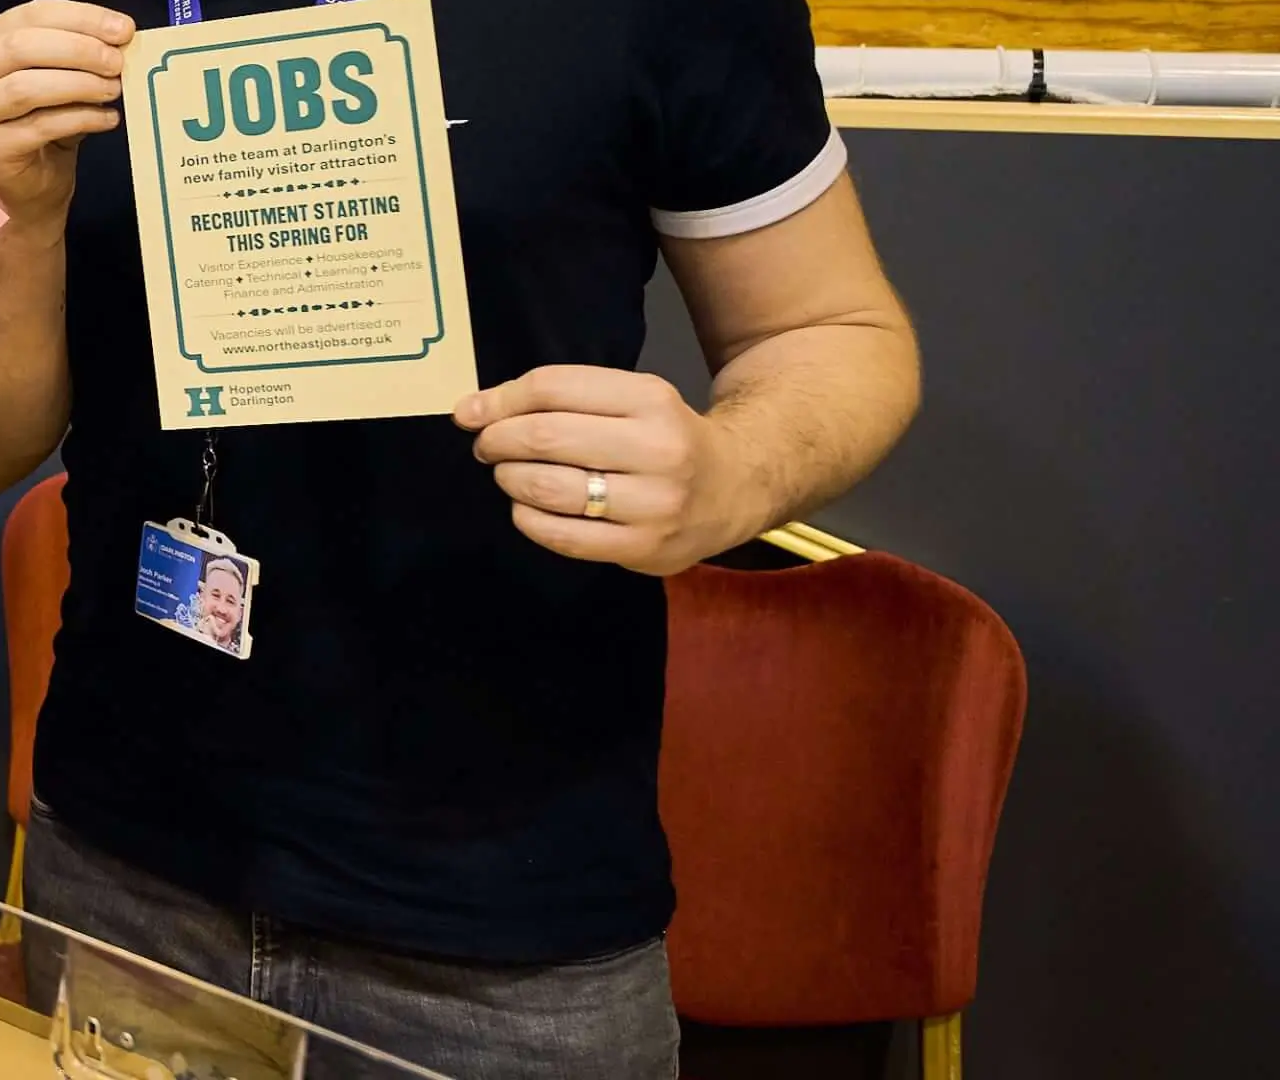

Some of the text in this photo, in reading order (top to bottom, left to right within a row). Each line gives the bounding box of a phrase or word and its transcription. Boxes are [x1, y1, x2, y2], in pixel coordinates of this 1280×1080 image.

[182, 50, 378, 142] JOBS
[180, 134, 396, 168] Join the team at Darlington's
[183, 153, 397, 184] new family visitor attraction
[191, 195, 400, 232] RECRUITMENT STARTING
[227, 223, 368, 252] THIS SPRING FOR
[184, 260, 423, 289] Catering Technical Learning Events
[198, 247, 403, 274] Visitor Experience Housekeeping
[223, 278, 384, 300] Finance and Administration
[209, 318, 401, 341] Vacancies will be advertised on
[223, 334, 392, 355] www.northeastjobs.org.uk
[229, 383, 291, 395] Hopetown
[230, 394, 294, 408] Darlington
